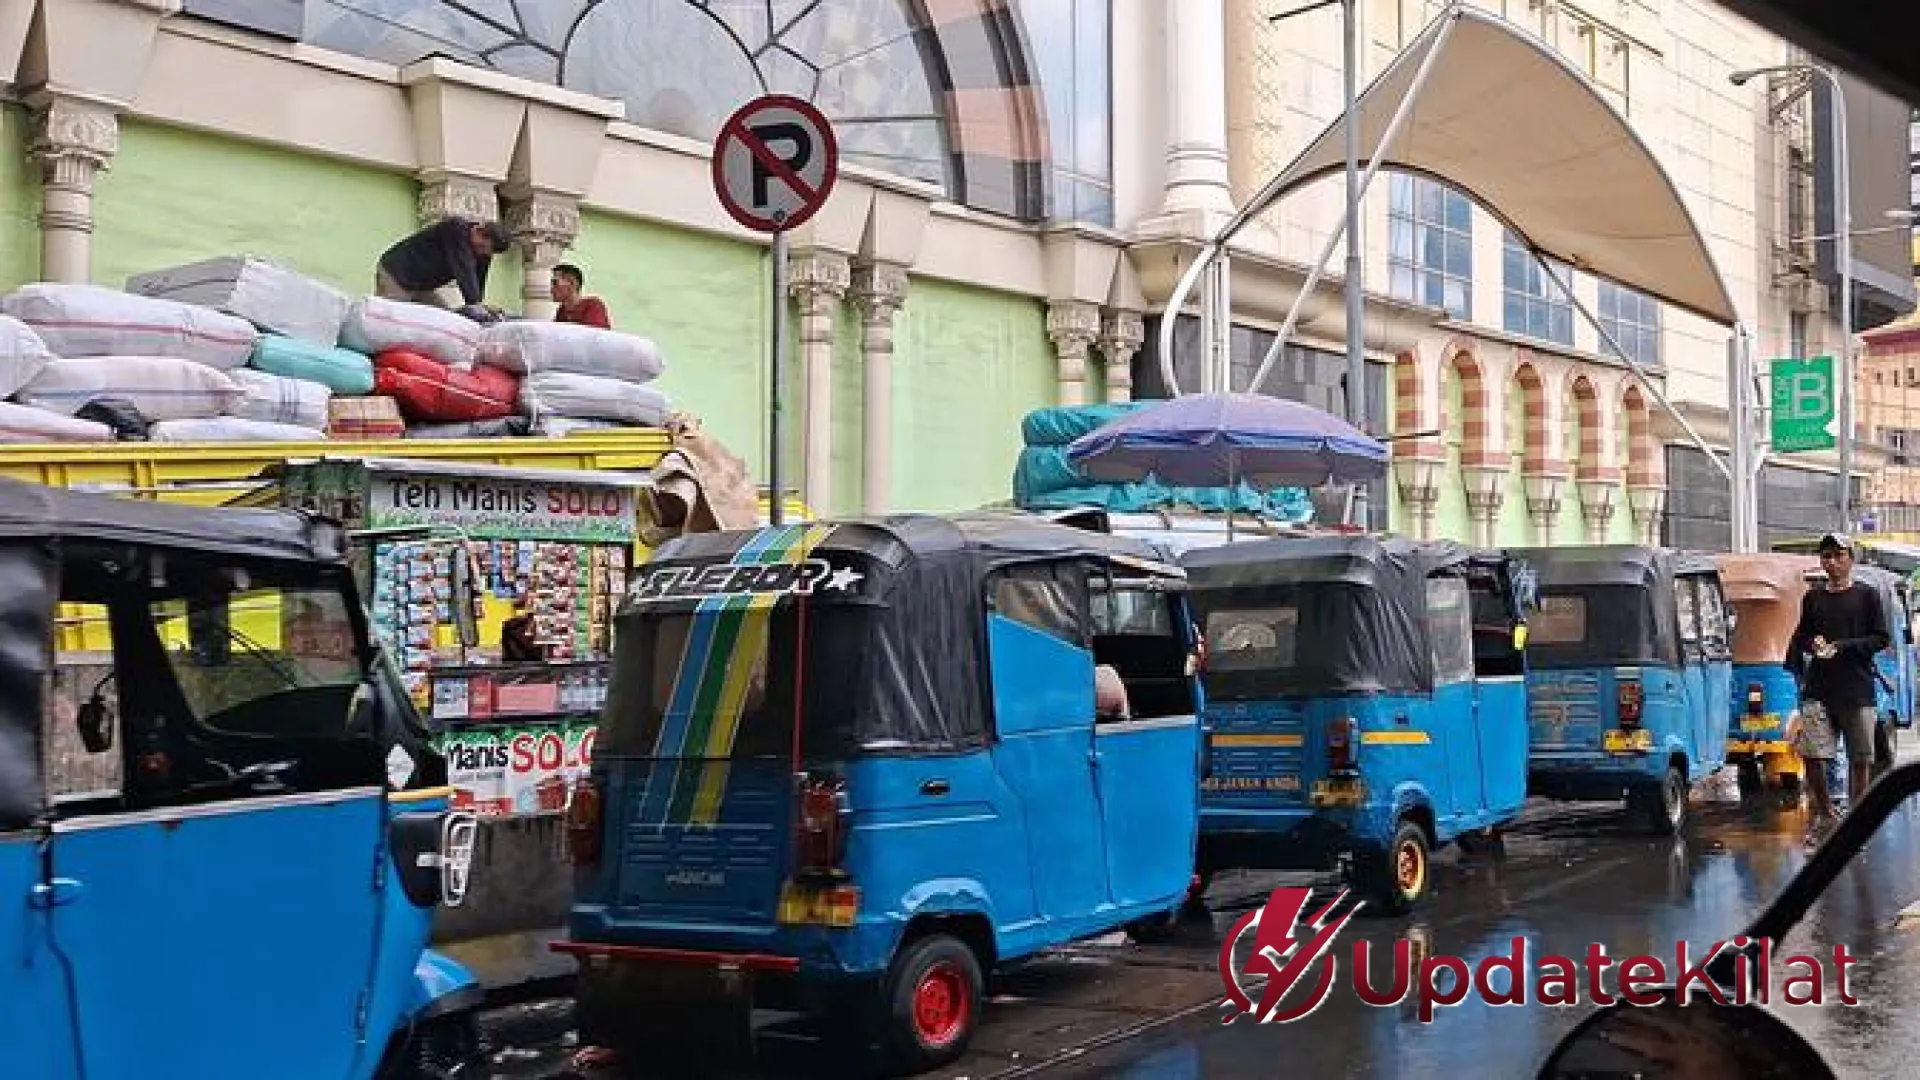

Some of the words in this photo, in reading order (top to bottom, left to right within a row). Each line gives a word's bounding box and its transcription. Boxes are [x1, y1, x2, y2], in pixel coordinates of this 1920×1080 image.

[749, 122, 812, 208] P
[1792, 372, 1829, 417] B
[388, 478, 440, 508] Teh
[453, 478, 537, 514] Manis
[547, 486, 620, 516] SOLO
